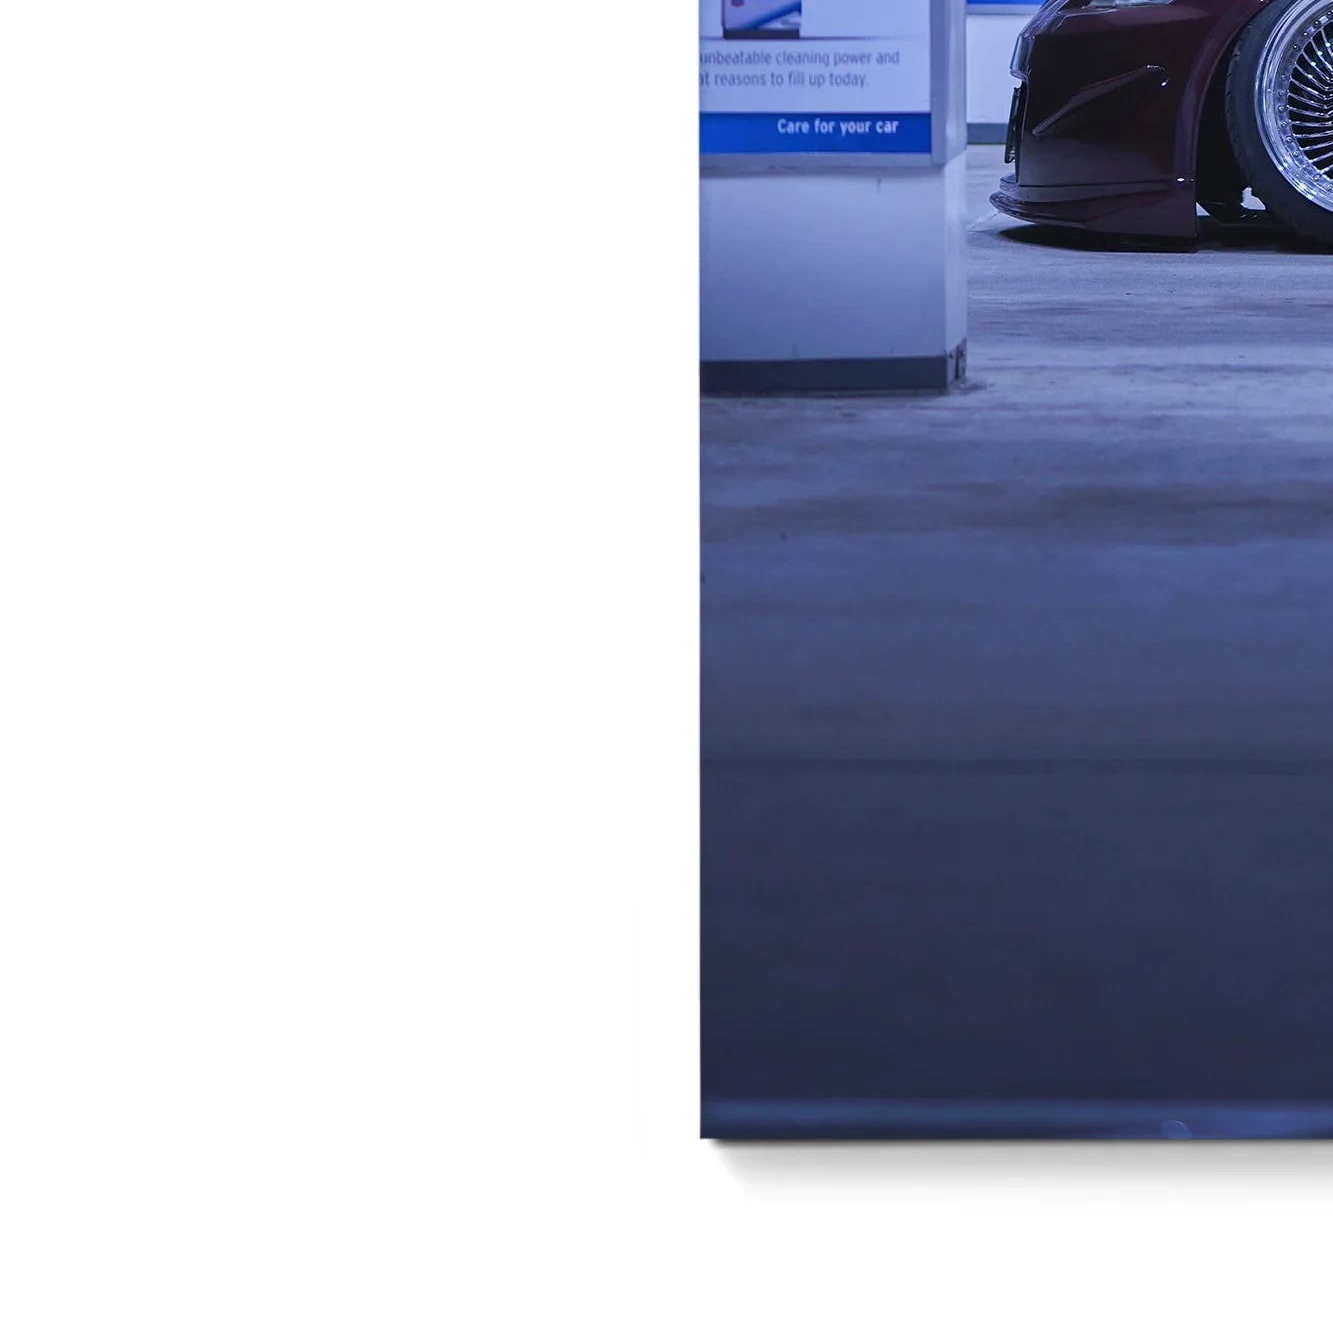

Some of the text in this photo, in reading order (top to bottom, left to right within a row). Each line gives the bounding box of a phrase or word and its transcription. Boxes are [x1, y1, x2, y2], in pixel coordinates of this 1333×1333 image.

[776, 51, 829, 67] cleaning
[834, 52, 871, 67] power
[876, 51, 900, 65] and
[714, 74, 766, 87] reasons
[771, 73, 784, 86] to
[788, 71, 805, 86] fill
[809, 74, 825, 89] up
[777, 118, 899, 136] Care for your car
